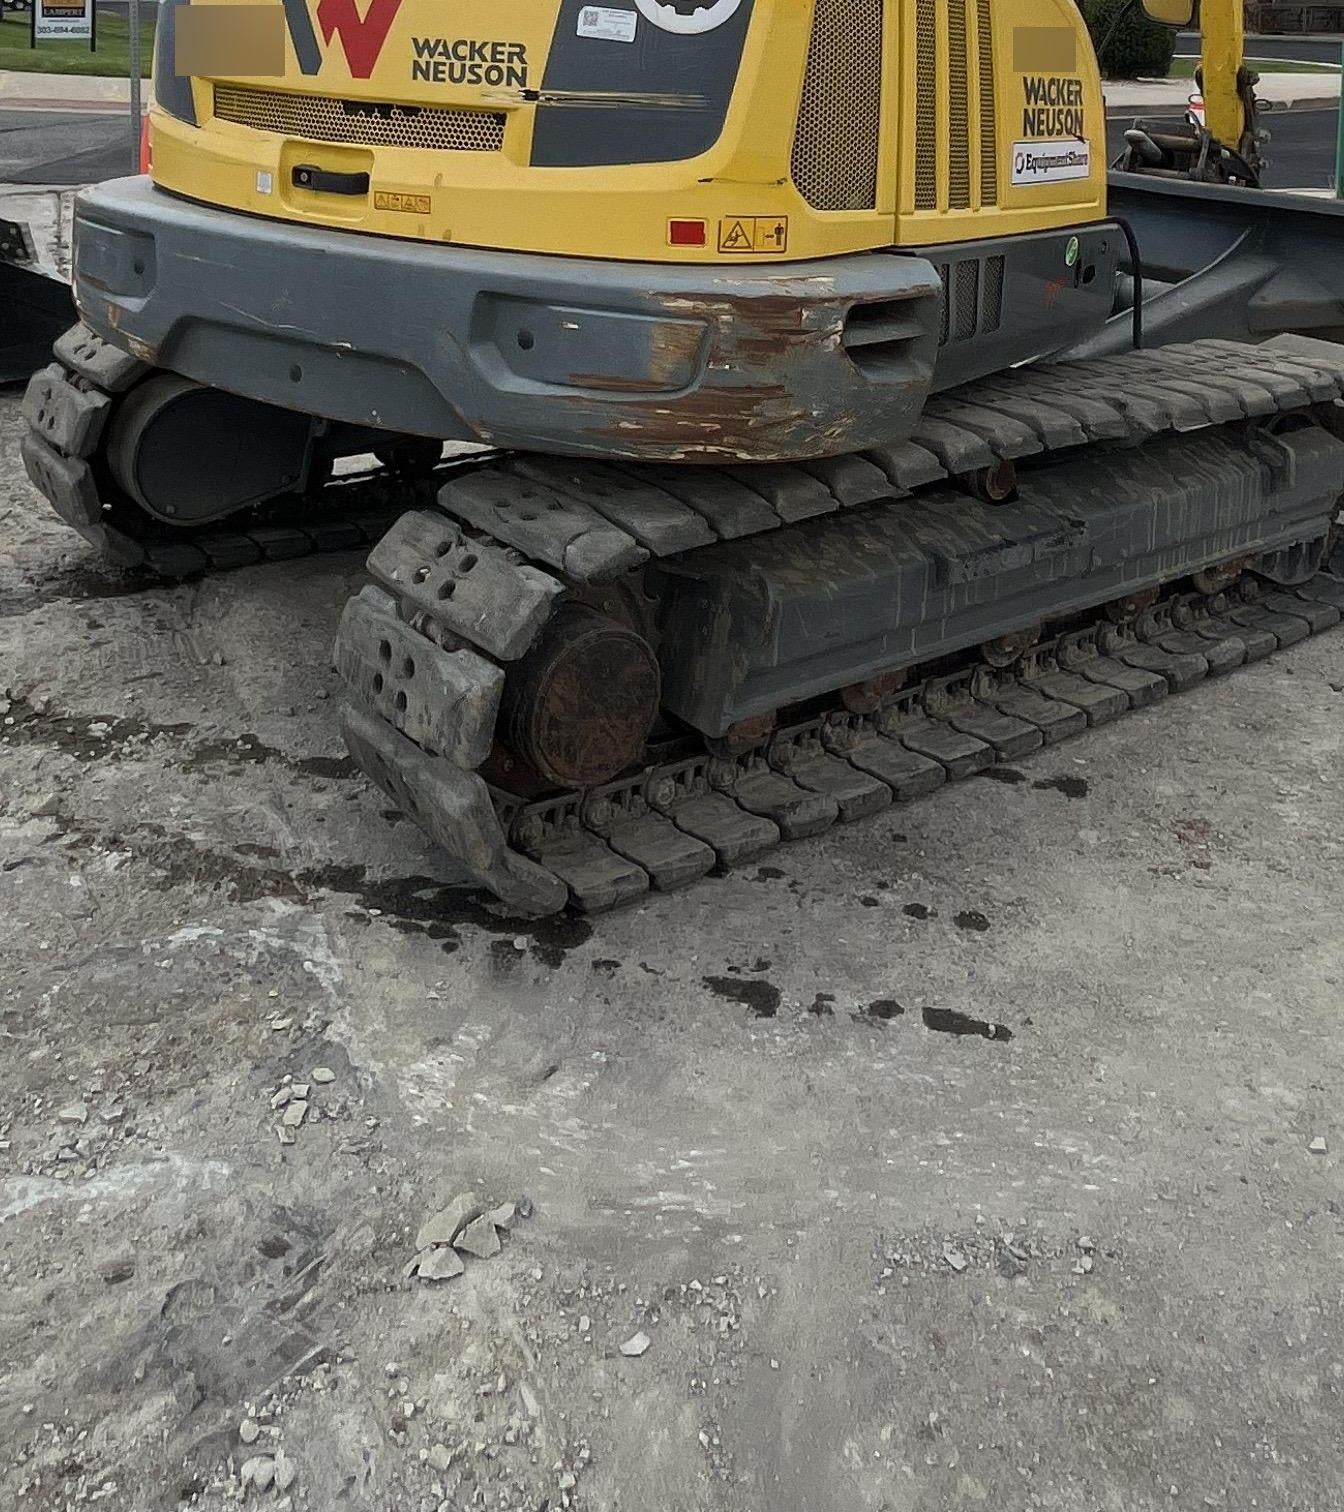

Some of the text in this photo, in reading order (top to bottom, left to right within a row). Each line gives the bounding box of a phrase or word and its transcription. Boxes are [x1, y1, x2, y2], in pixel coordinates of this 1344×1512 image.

[411, 37, 528, 65] WACKER
[411, 60, 528, 88] NEUSON
[1023, 76, 1083, 106] WACKER
[1023, 108, 1084, 138] NEUSON
